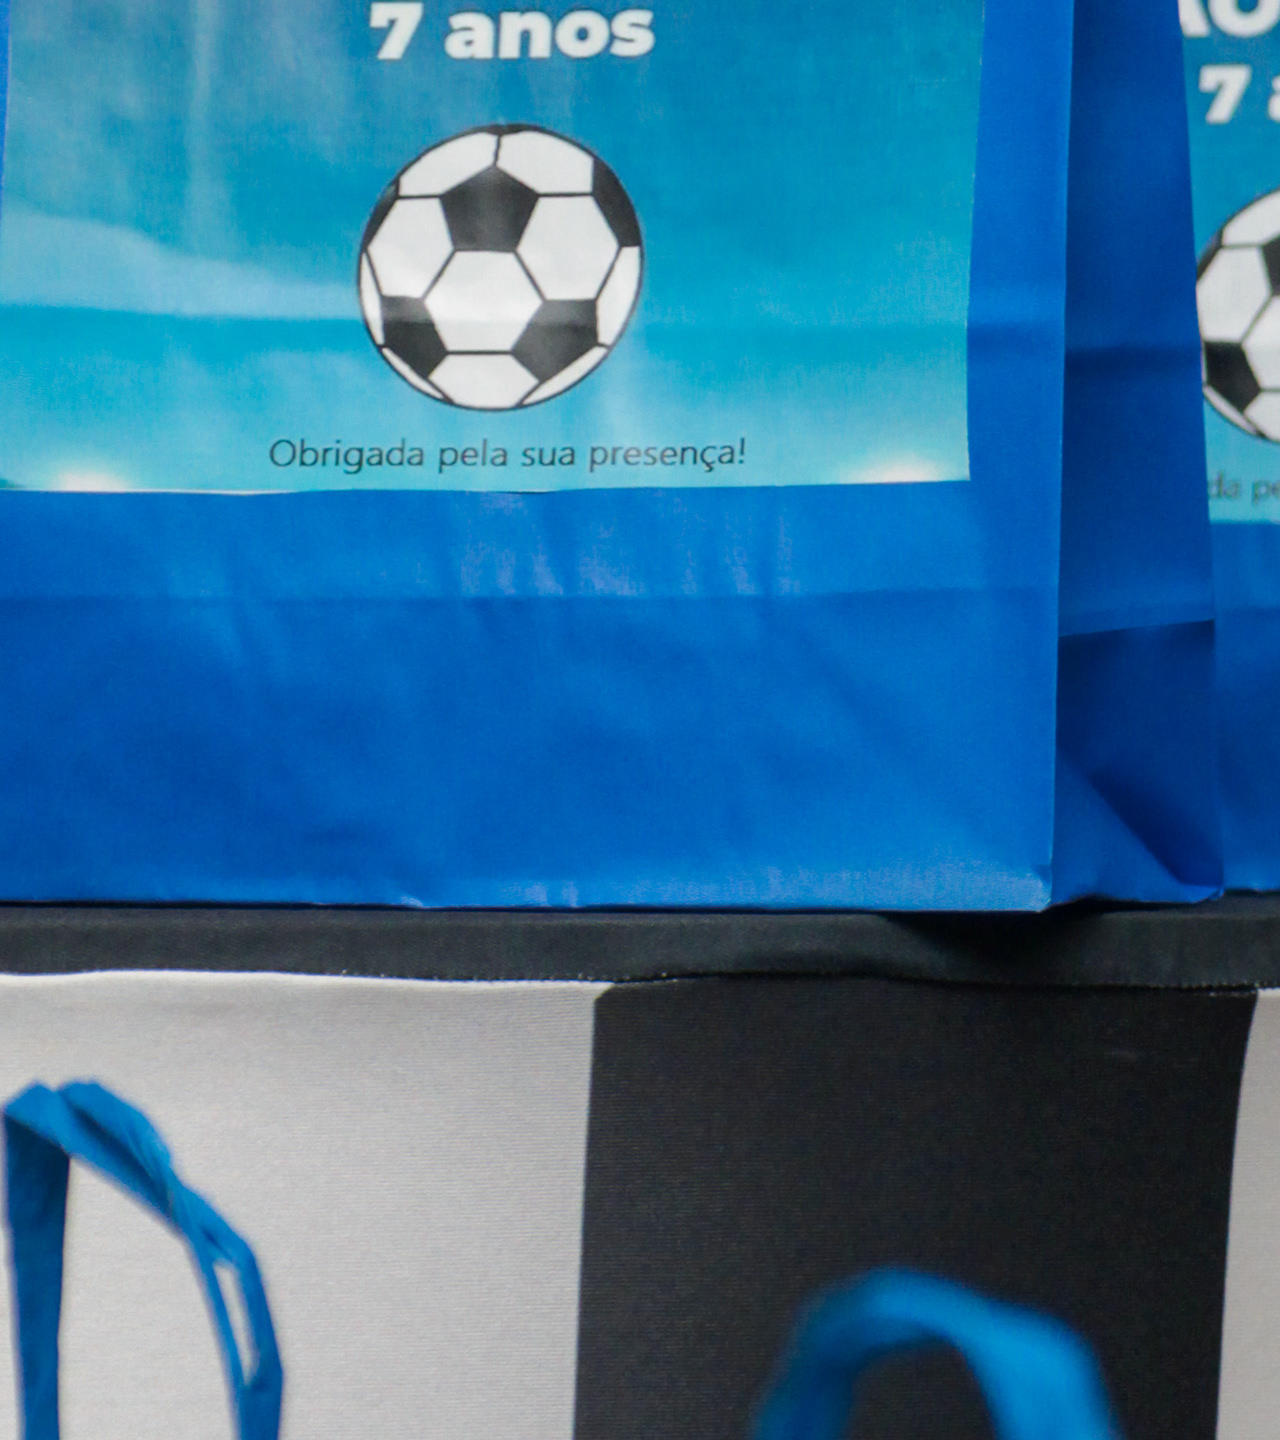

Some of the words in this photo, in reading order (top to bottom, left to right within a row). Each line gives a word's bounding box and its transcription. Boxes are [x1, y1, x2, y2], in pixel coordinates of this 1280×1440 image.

[369, 2, 423, 60] 7
[443, 8, 656, 60] anos
[1198, 64, 1252, 124] 7
[269, 438, 424, 474] Obrigada
[437, 438, 508, 474] pela
[520, 443, 576, 467] sua
[588, 437, 746, 473] presença!
